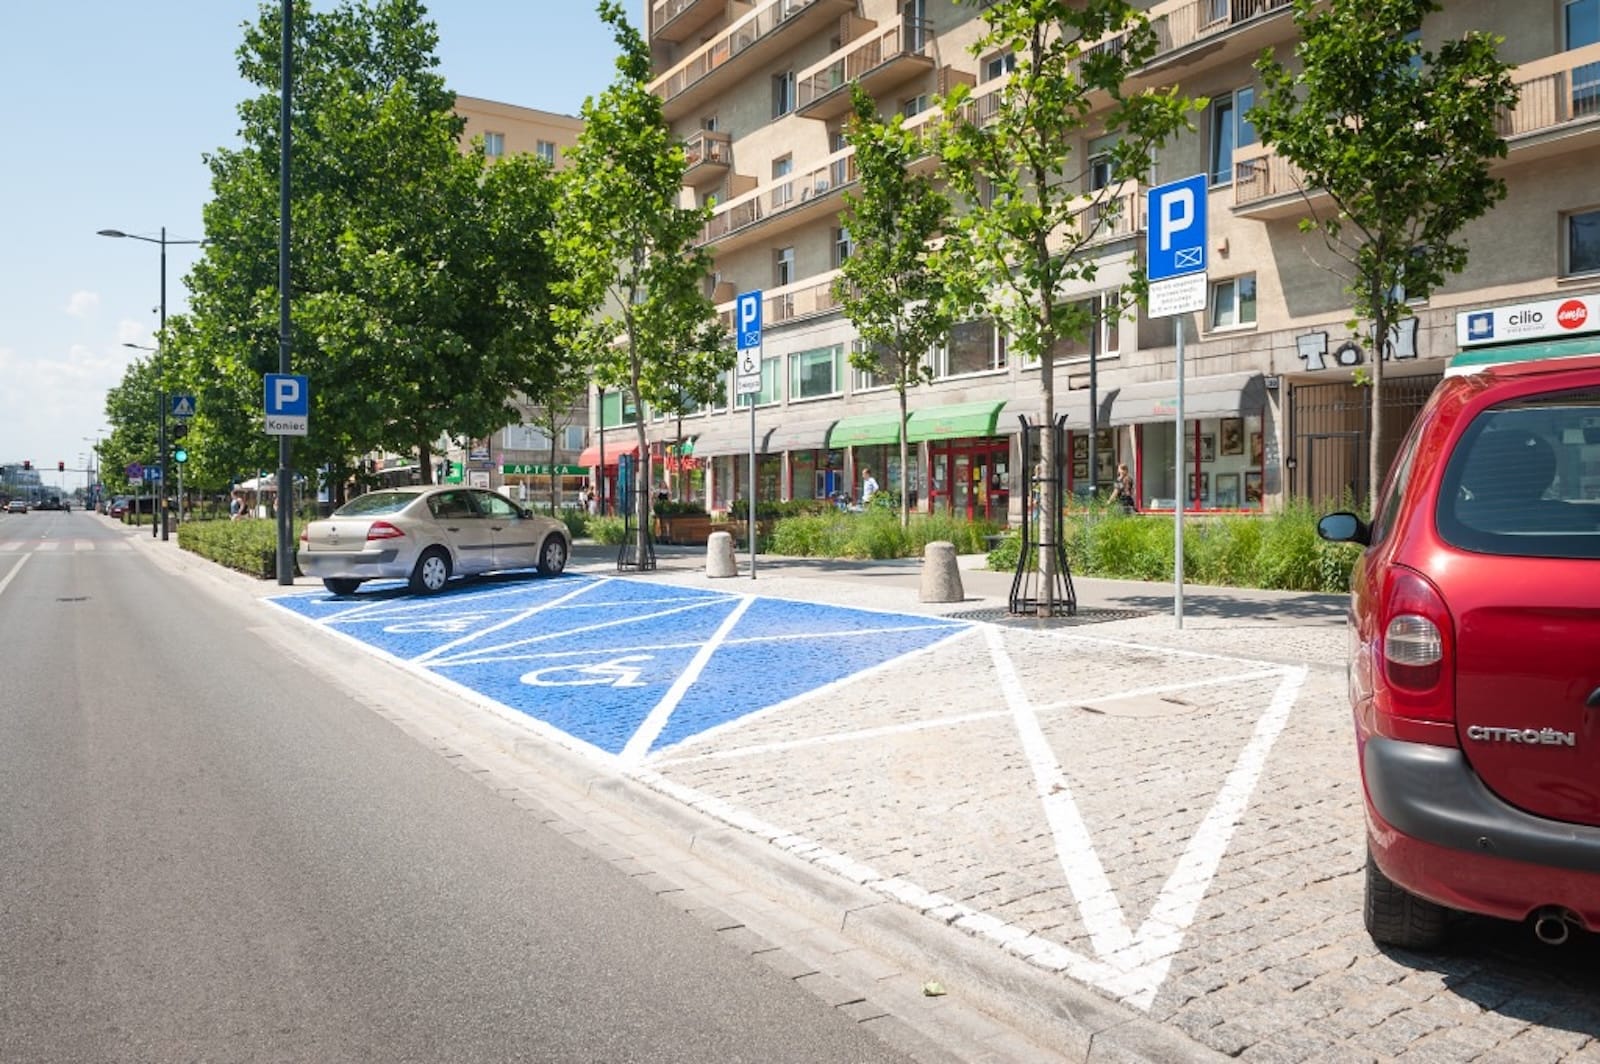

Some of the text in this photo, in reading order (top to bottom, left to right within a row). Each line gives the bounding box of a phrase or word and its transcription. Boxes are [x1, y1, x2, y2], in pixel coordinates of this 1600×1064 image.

[1160, 187, 1195, 252] P
[741, 296, 757, 333] P
[1509, 310, 1543, 326] cilio
[275, 378, 300, 411] P
[268, 420, 306, 431] Koniec
[1466, 725, 1577, 747] CITROËN
